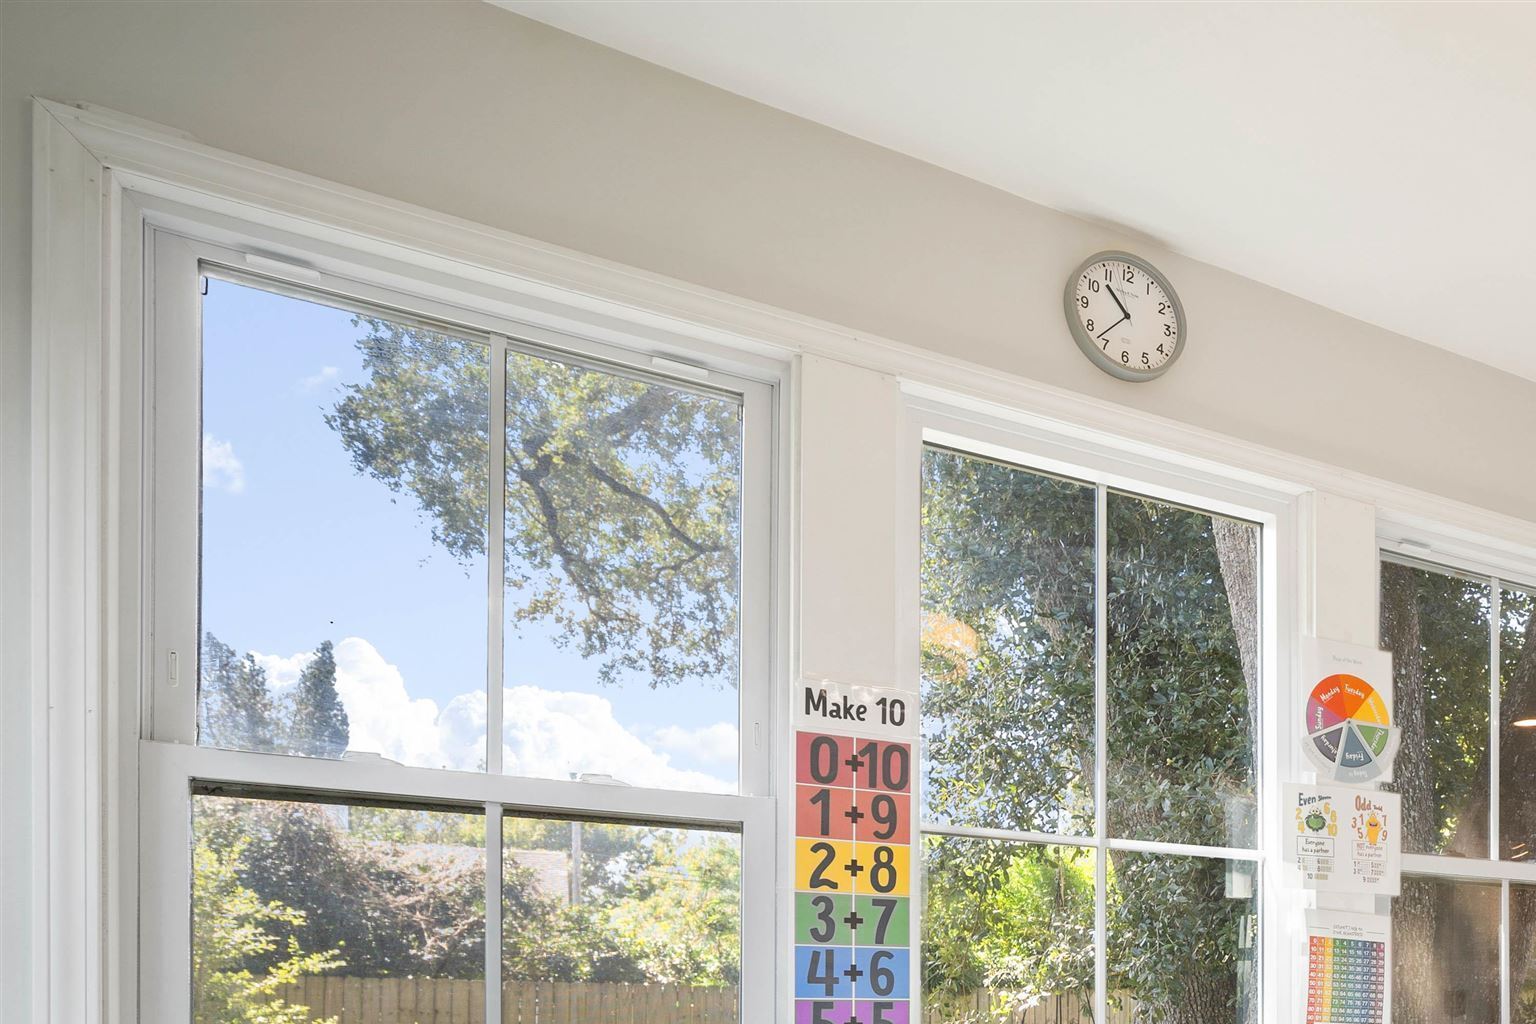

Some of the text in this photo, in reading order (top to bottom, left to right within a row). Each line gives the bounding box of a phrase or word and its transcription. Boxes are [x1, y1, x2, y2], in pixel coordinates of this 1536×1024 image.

[1105, 269, 1112, 282] 11
[1123, 269, 1135, 284] 12
[1088, 279, 1099, 292] 10
[1146, 283, 1150, 295] 1
[1081, 296, 1089, 308] 9
[1158, 303, 1166, 315] 2
[1086, 319, 1094, 332] 8
[1164, 324, 1171, 336] 3
[1102, 338, 1109, 350] 7
[1156, 344, 1164, 354] 4
[1121, 351, 1129, 363] 6
[1141, 352, 1149, 364] 5
[1319, 686, 1341, 703] Monday
[1344, 683, 1365, 699] Tuesday
[805, 686, 905, 726] Make 10
[1314, 706, 1324, 730] Sunday
[1345, 752, 1365, 761] Friday
[1298, 792, 1316, 806] Even
[1355, 795, 1372, 811] Odd
[1296, 808, 1302, 820] 2
[1324, 802, 1330, 814] 6
[1351, 817, 1357, 828] 3
[1359, 813, 1364, 825] 1
[1382, 815, 1387, 826] 7
[1328, 823, 1337, 836] 10
[1358, 827, 1363, 839] 5
[1382, 830, 1388, 841] 9
